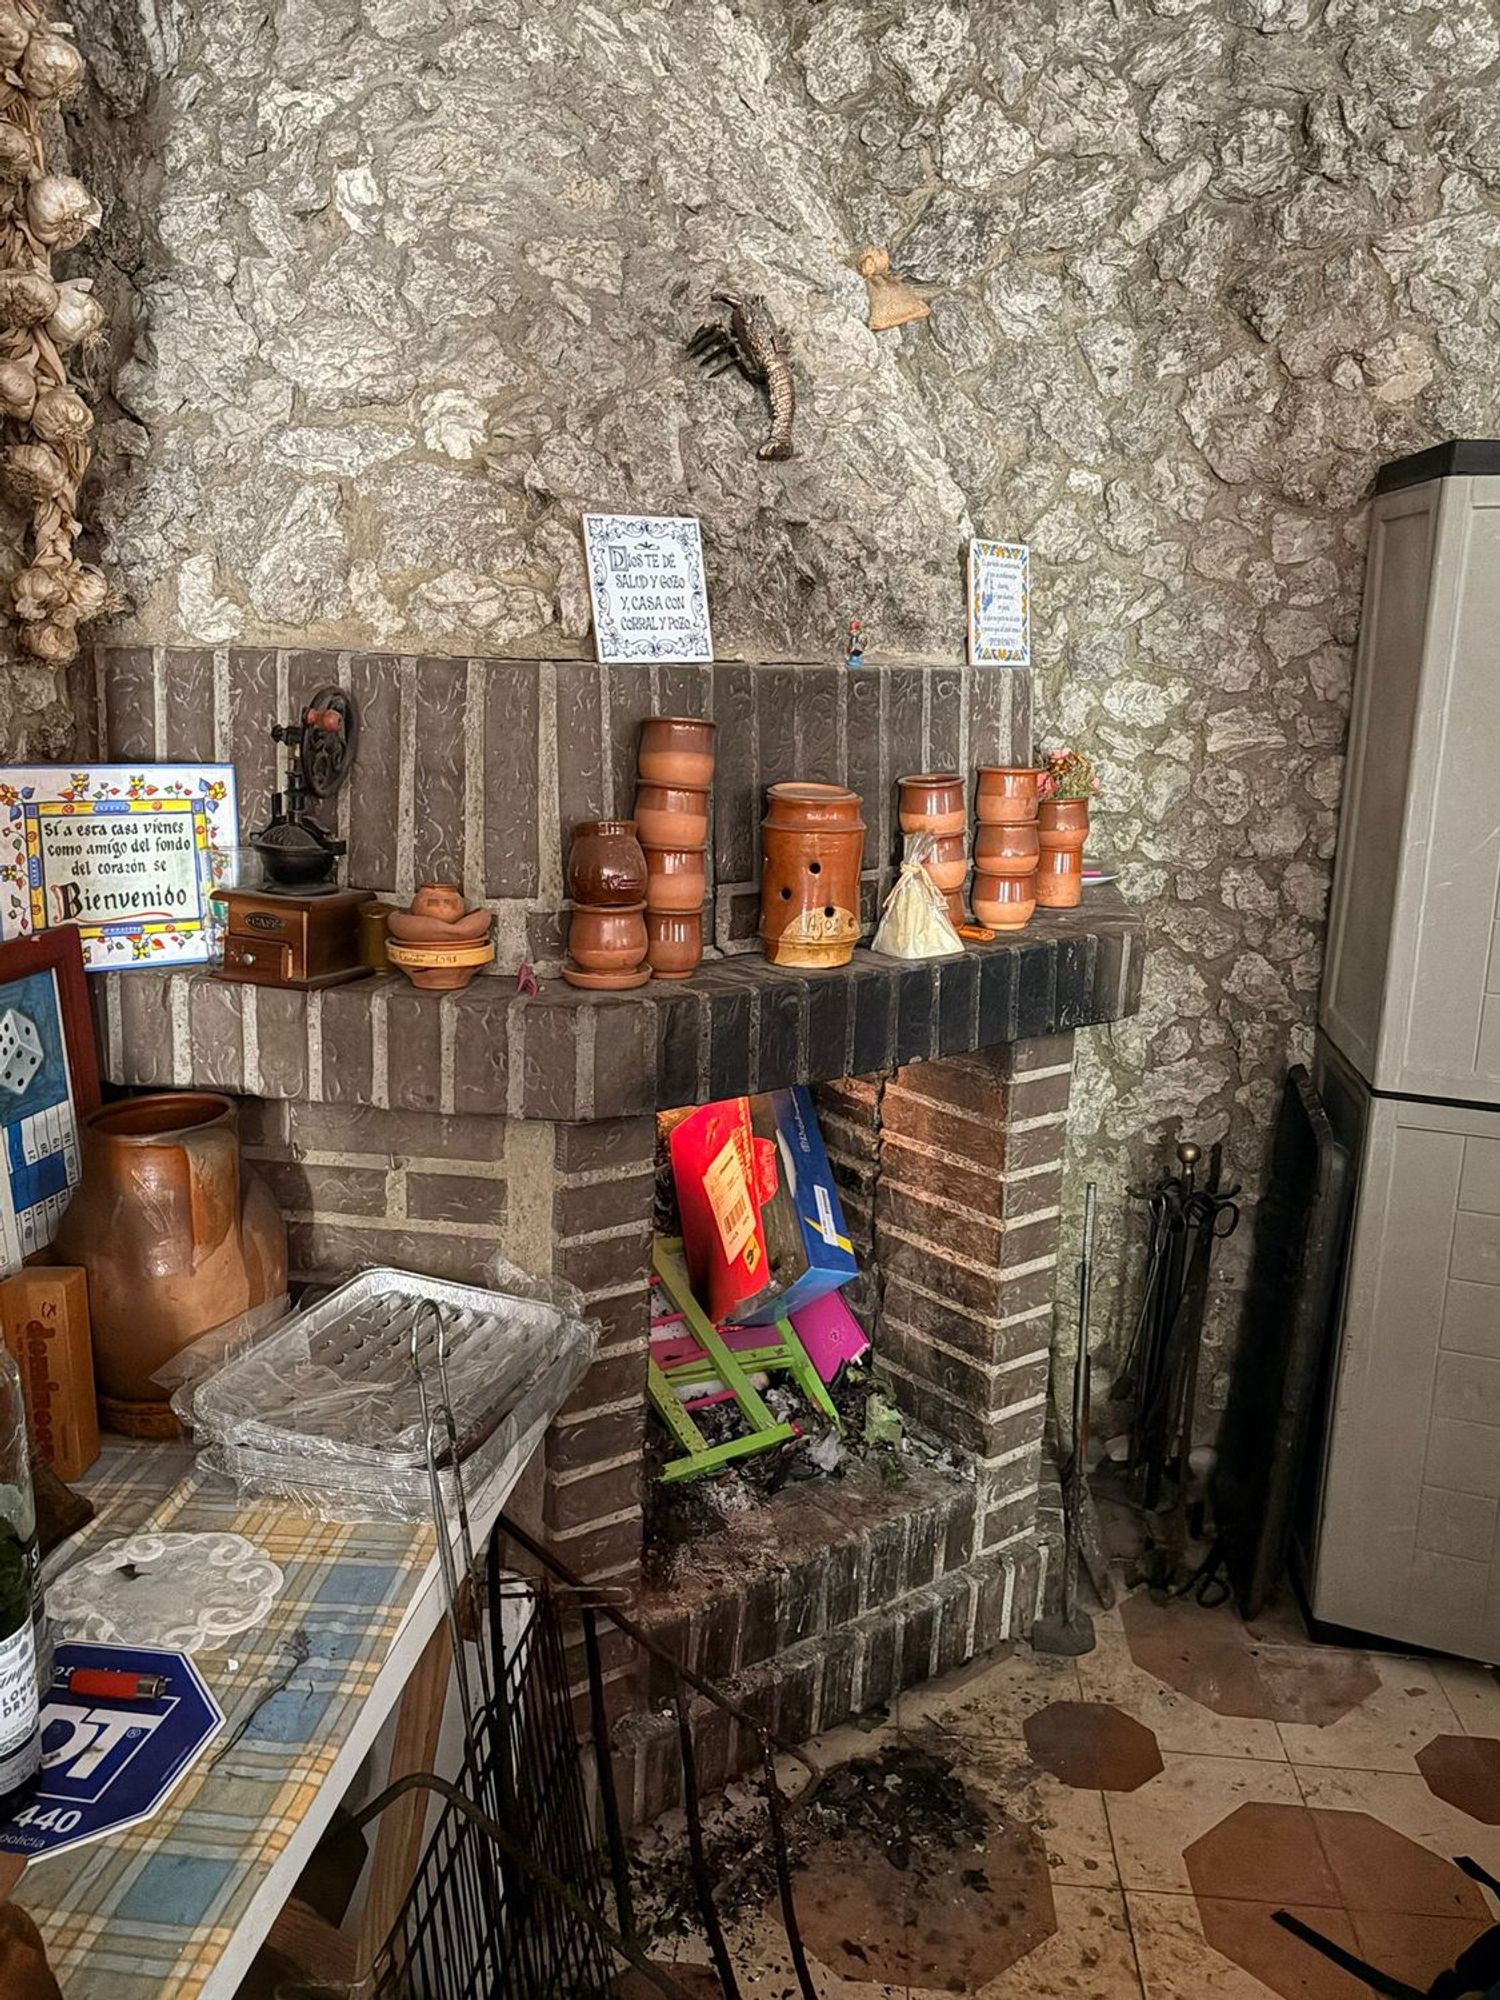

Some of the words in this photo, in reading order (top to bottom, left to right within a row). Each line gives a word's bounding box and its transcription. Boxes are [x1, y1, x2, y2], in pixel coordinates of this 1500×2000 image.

[644, 553, 660, 568] TE
[615, 574, 648, 589] SALUD
[650, 575, 658, 589] Y
[631, 596, 663, 611] CASA
[665, 596, 685, 610] CON
[621, 616, 659, 631] CORRAL
[659, 617, 666, 631] Y
[64, 825, 73, 837] a
[77, 824, 107, 837] esta
[111, 823, 139, 836] casa
[143, 818, 184, 834] vienes
[47, 844, 82, 858] como
[87, 839, 127, 859] amigo
[131, 838, 151, 854] del
[155, 837, 191, 853] fondo
[71, 859, 91, 877] del
[97, 859, 146, 875] corazón
[154, 859, 167, 872] se
[51, 882, 187, 921] Bienvenido
[41, 1142, 49, 1155] 20
[52, 1137, 60, 1149] 19
[28, 1149, 37, 1161] 21
[23, 1210, 32, 1222] 12
[36, 1204, 44, 1216] 13
[3, 1693, 27, 1718] DRY
[39, 1702, 163, 1780] DT
[12, 1804, 82, 1834] 440
